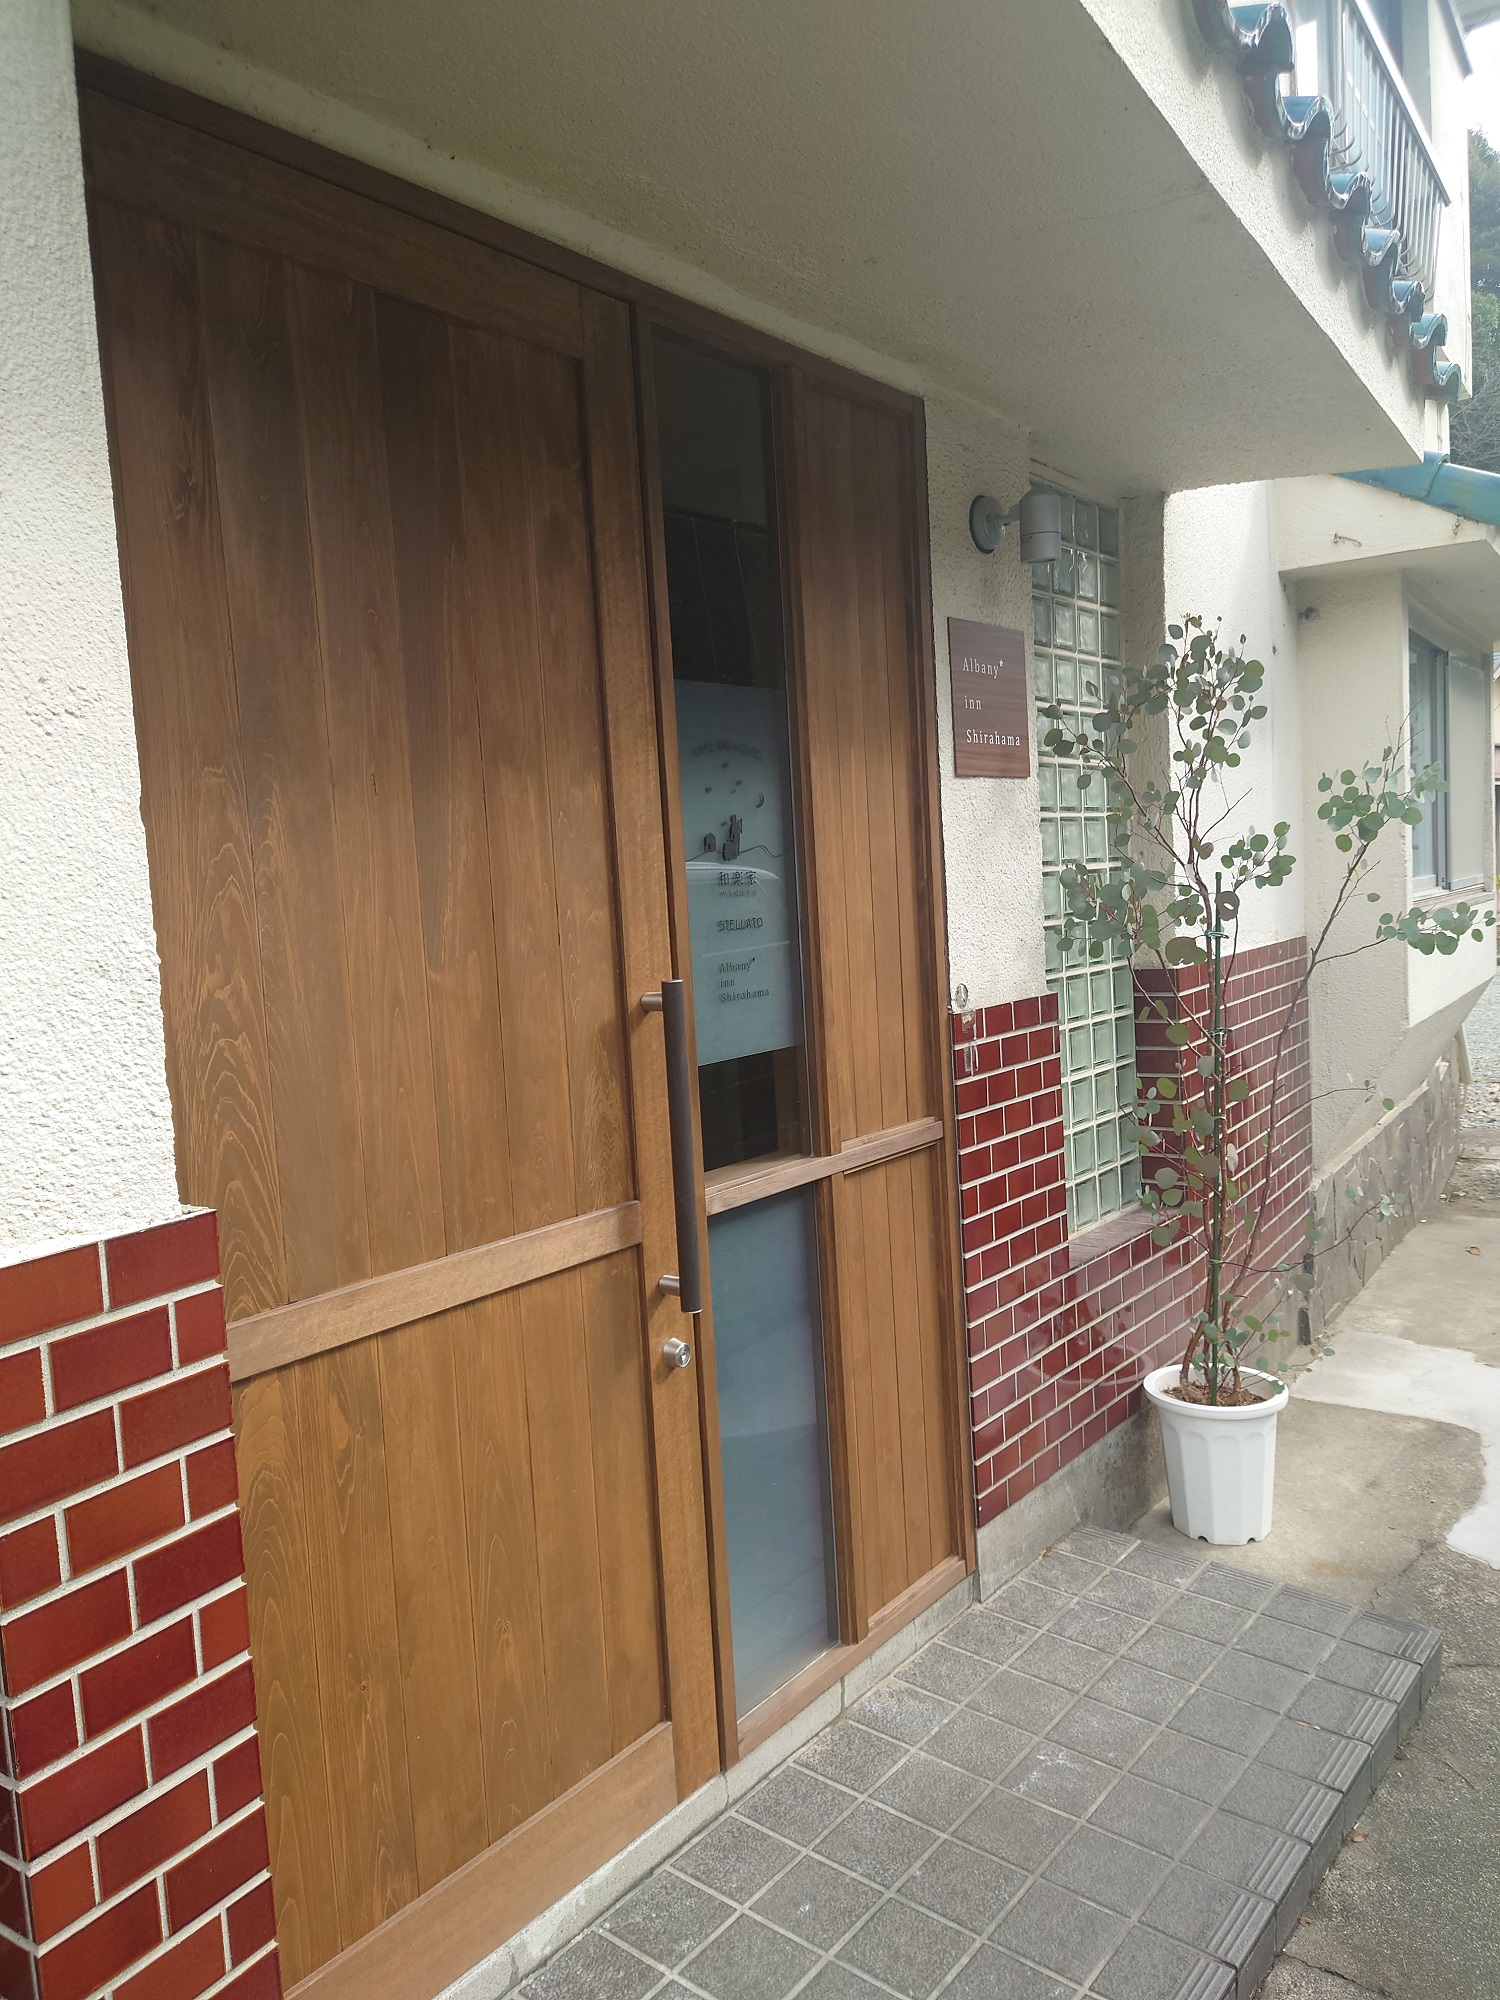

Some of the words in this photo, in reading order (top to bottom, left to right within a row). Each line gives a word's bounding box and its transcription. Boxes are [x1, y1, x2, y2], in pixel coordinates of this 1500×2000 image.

[964, 695, 982, 711] inn
[966, 729, 1021, 747] Shirahama
[718, 871, 757, 886] 和楽家
[717, 913, 763, 932] STELLATO
[719, 978, 735, 988] inn
[719, 988, 770, 1003] Shirahama
